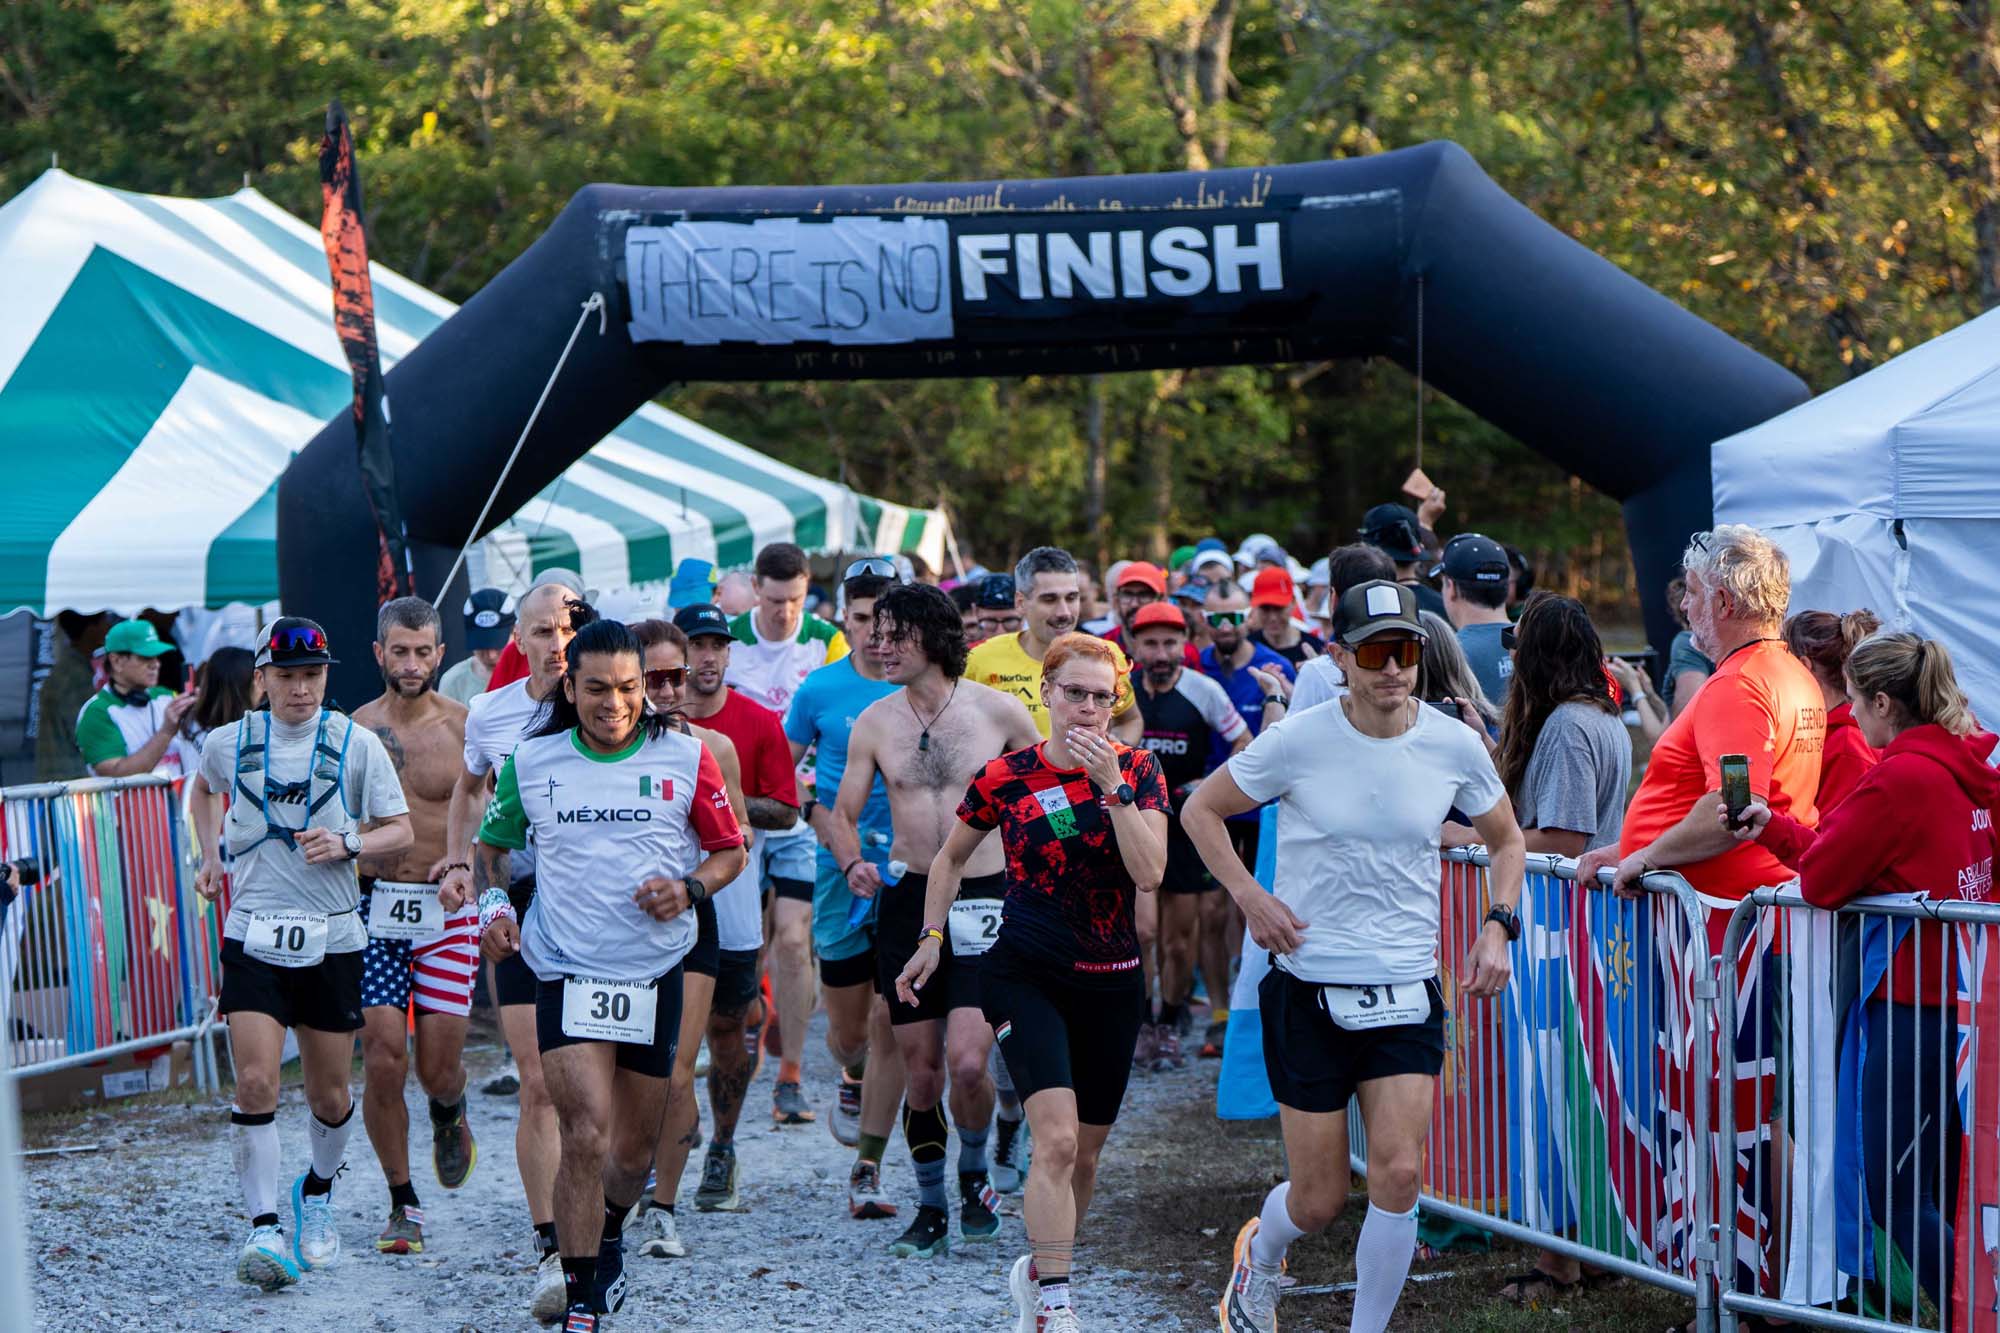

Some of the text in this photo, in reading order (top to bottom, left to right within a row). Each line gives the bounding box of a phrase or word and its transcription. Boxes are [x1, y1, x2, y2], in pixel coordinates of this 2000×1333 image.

[957, 222, 1284, 301] FINISH
[631, 240, 942, 330] THERE IS NO
[557, 805, 652, 824] MÉXICO
[391, 887, 423, 895] Backyard
[272, 913, 306, 922] Backyard
[308, 914, 326, 923] Ultra
[390, 899, 422, 923] 45
[273, 925, 305, 951] 10
[982, 914, 997, 939] 2
[1112, 956, 1139, 970] FINISH
[568, 977, 589, 985] Big's
[592, 978, 631, 987] Backyard
[590, 990, 630, 1022] 30
[1358, 984, 1396, 1009] 31
